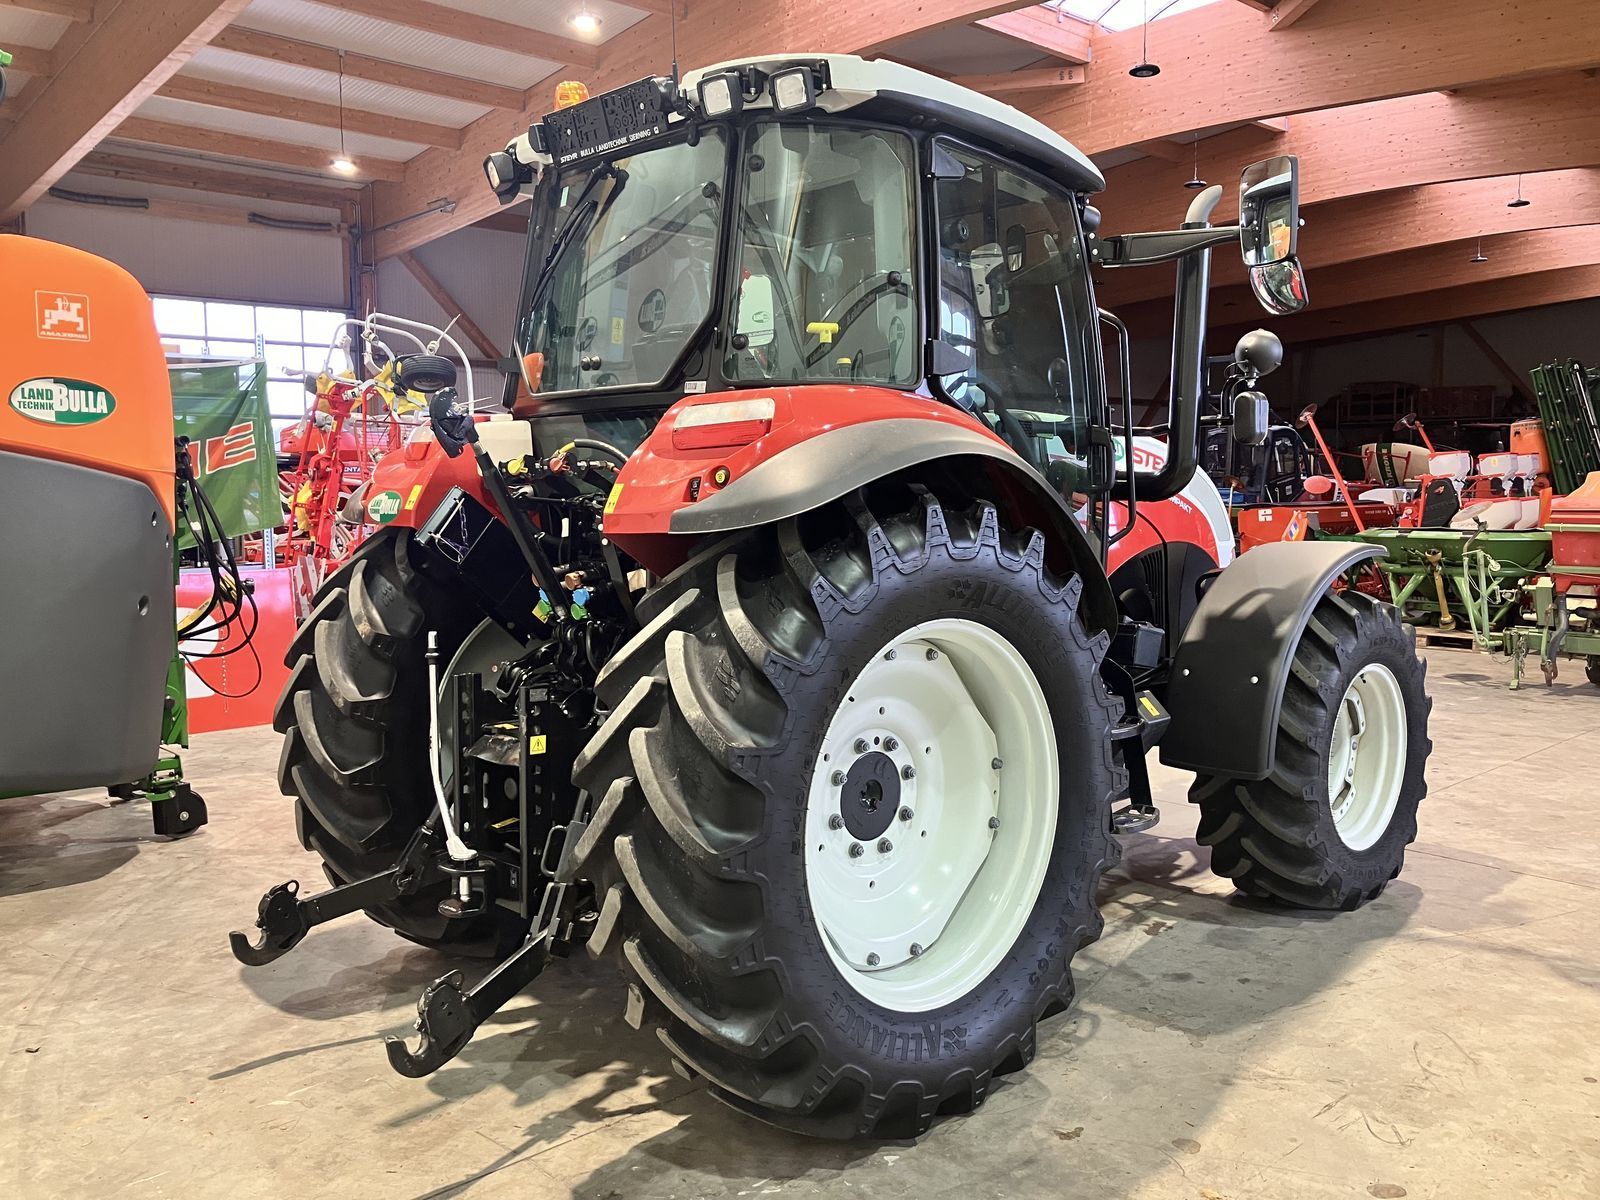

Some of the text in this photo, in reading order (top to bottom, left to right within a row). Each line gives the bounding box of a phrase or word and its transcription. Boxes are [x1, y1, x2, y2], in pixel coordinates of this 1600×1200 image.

[560, 128, 652, 164] STEYR BULLA LANDTECHNIK SIERNING
[40, 331, 88, 339] AMAZONE
[20, 387, 54, 400] LAND
[54, 382, 108, 414] BULLA
[17, 400, 55, 411] TECHNIK
[823, 990, 943, 1062] ALLIANCE
